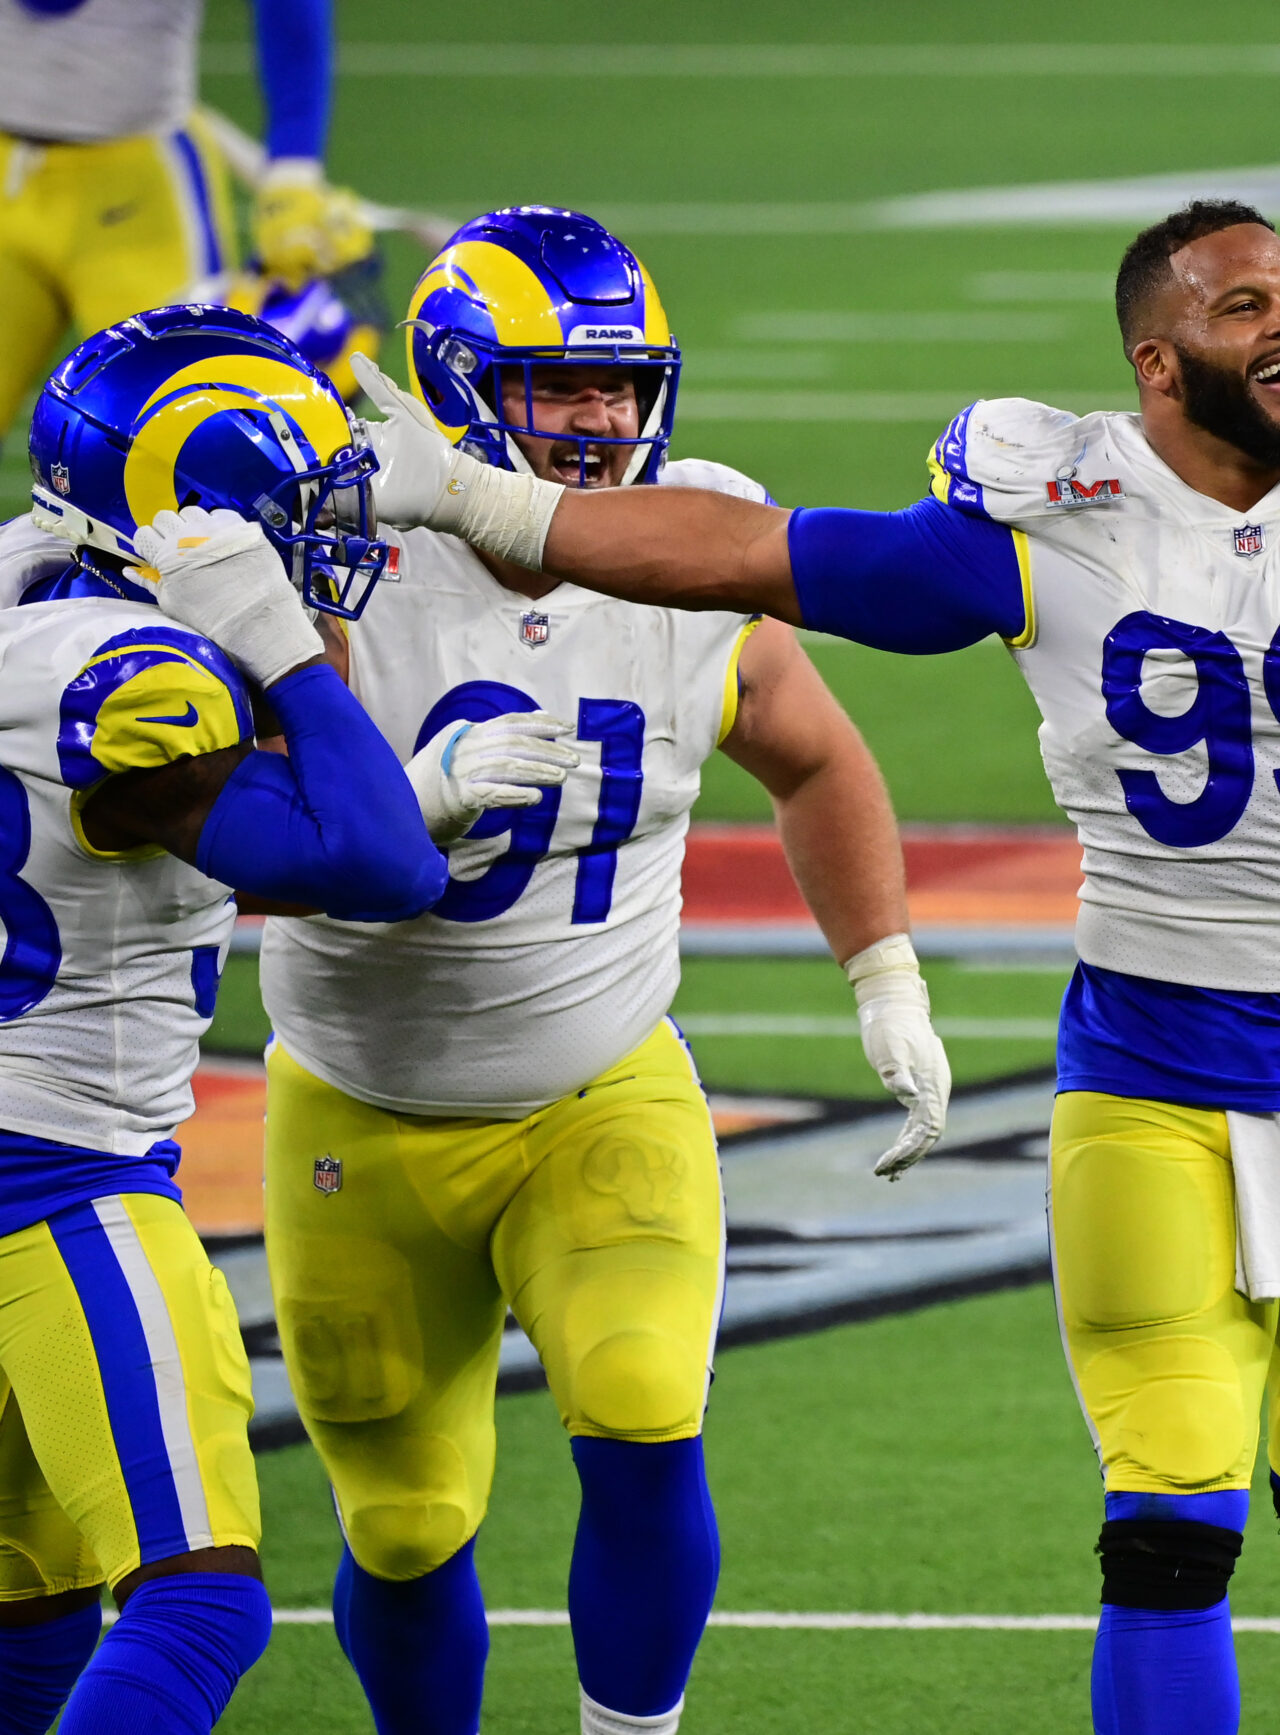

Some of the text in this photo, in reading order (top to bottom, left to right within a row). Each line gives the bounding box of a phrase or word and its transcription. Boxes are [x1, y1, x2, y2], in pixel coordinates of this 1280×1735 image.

[585, 329, 634, 340] RAMS
[1237, 535, 1261, 552] NFL
[525, 624, 546, 642] NFL
[412, 680, 646, 925] 91
[317, 1172, 337, 1188] NFL
